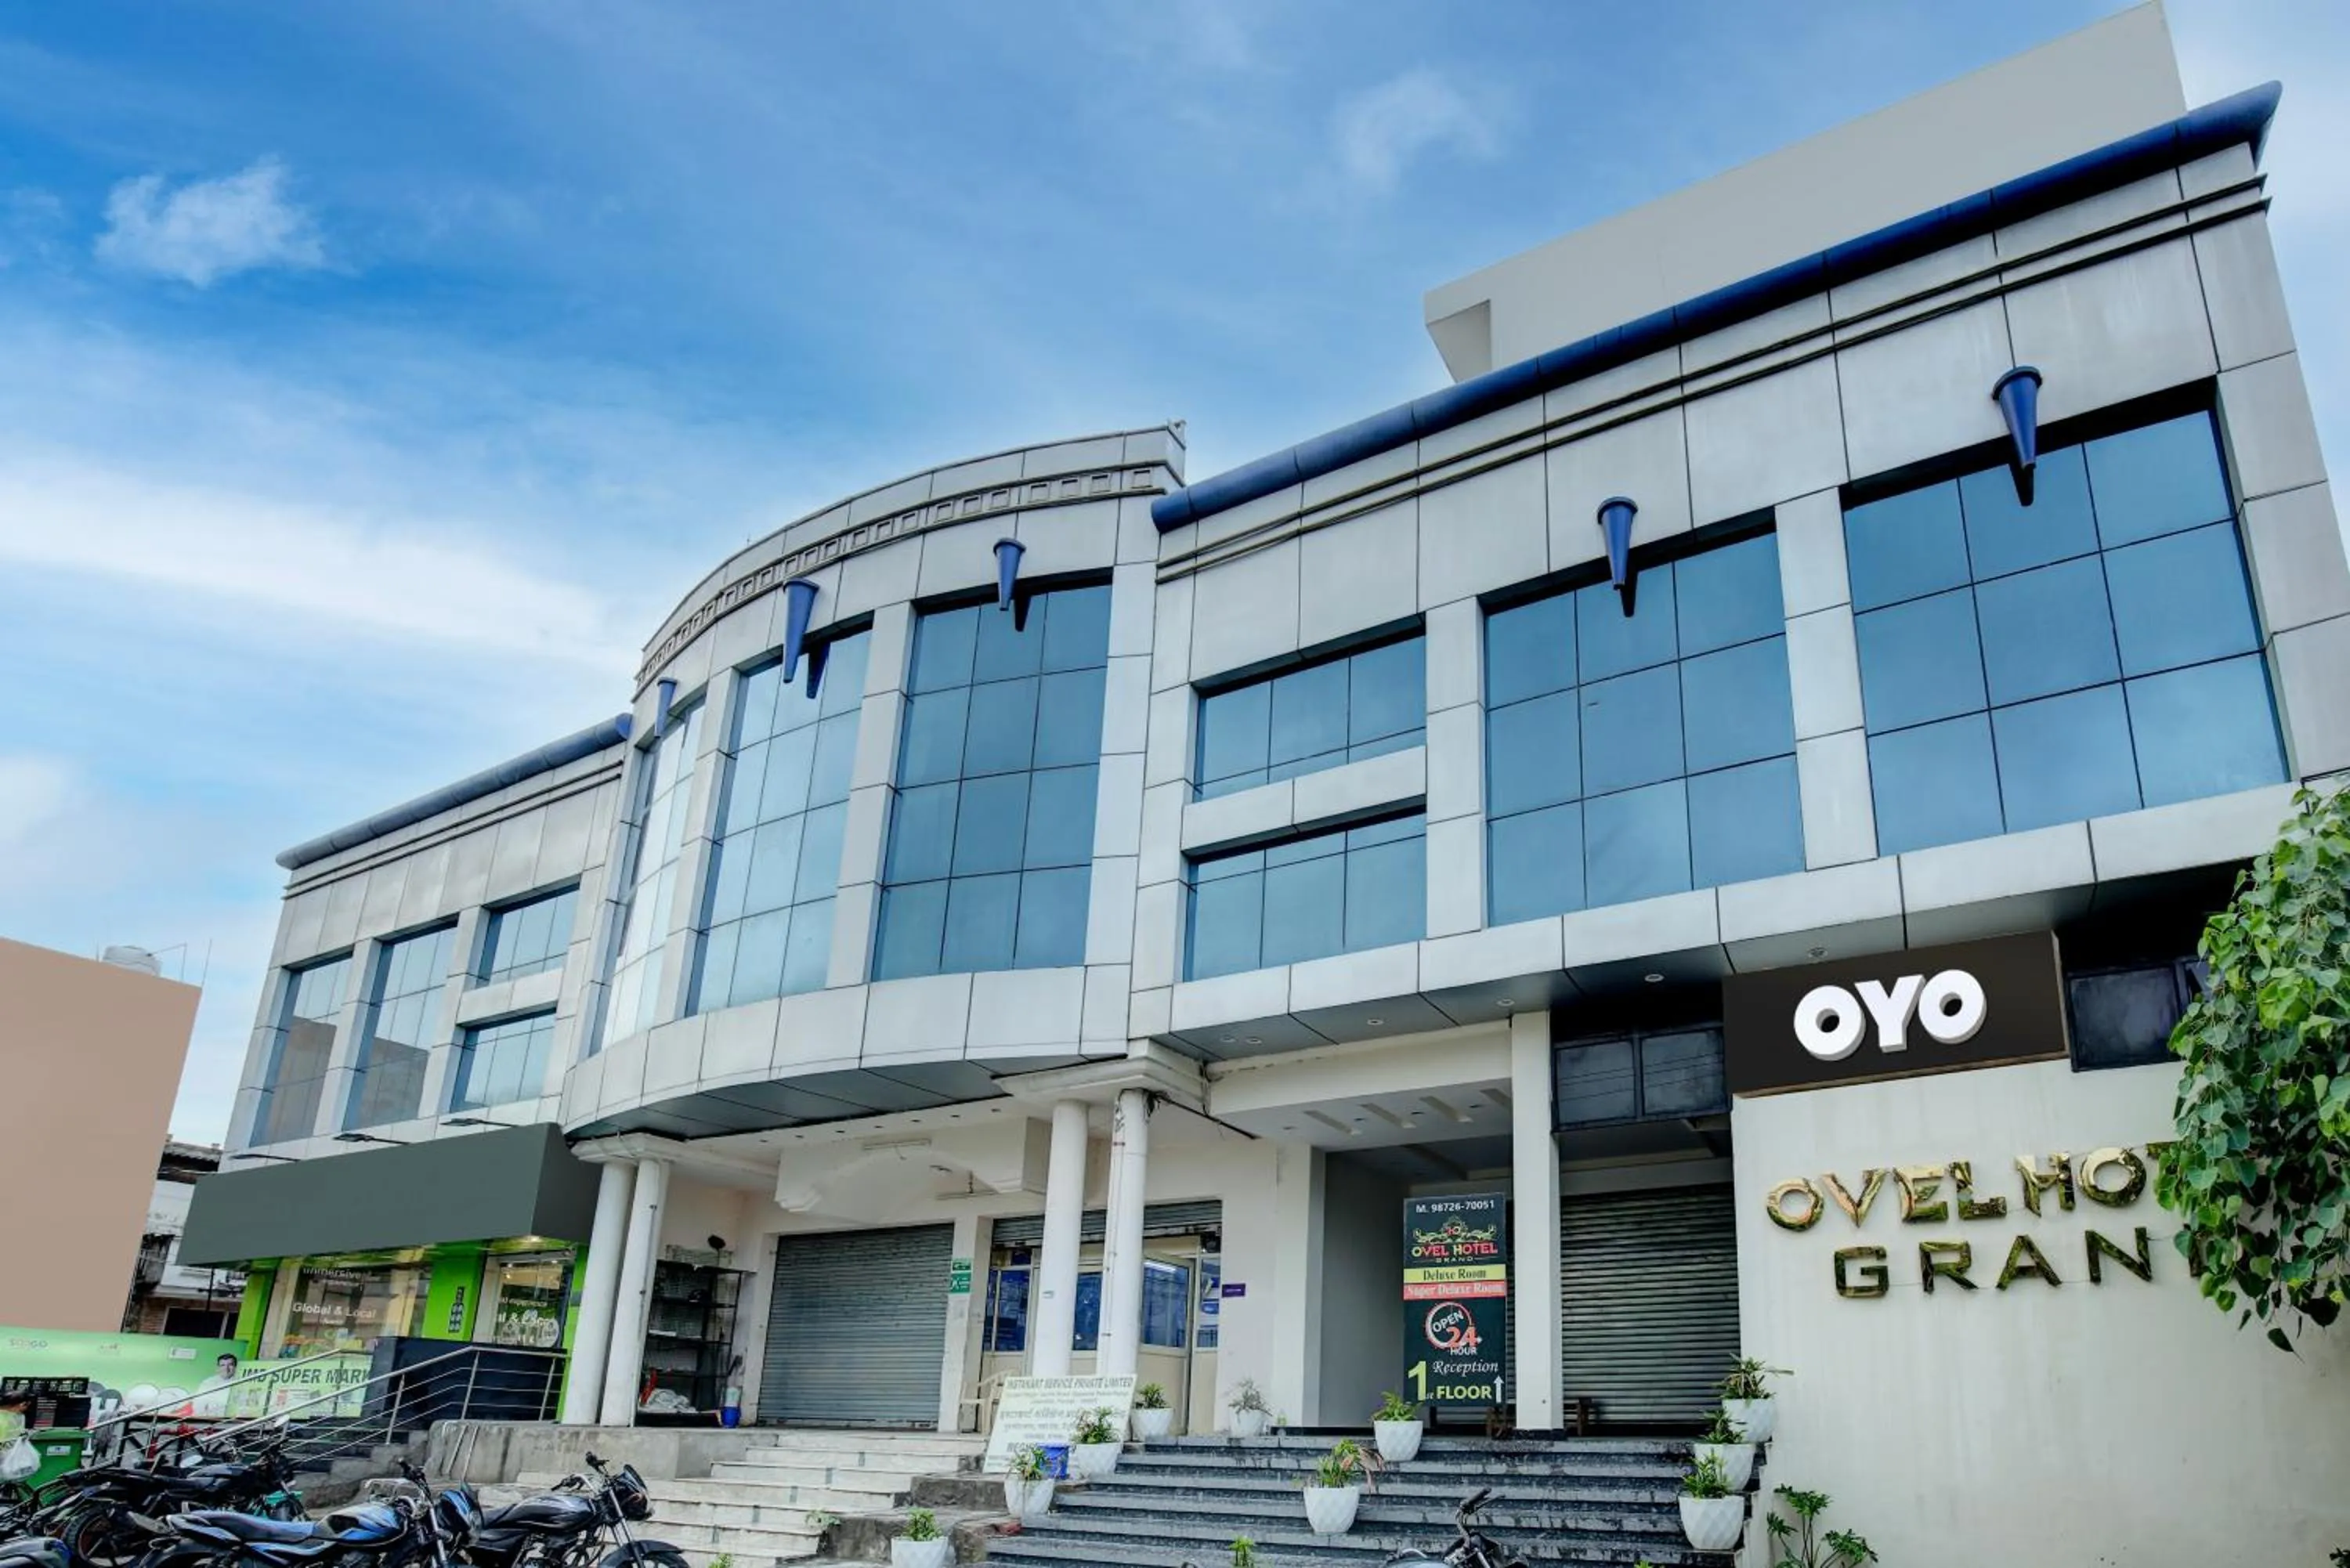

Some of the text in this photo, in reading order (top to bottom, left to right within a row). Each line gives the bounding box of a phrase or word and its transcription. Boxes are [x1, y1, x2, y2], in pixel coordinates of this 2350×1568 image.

[1793, 969, 1987, 1062] OYO
[1766, 1159, 2008, 1233] OVEL
[1411, 1241, 1499, 1257] OVEL HOTEL
[1423, 1267, 1487, 1281] Deluxe Room
[292, 1302, 331, 1316] Global
[345, 1306, 378, 1320] Local
[1433, 1310, 1465, 1333] OPEN
[1446, 1325, 1478, 1348] 24
[1449, 1346, 1478, 1356] HOUR
[271, 1368, 321, 1384] SUPER
[1432, 1358, 1499, 1378] Reception
[1437, 1385, 1493, 1400] FLOOR
